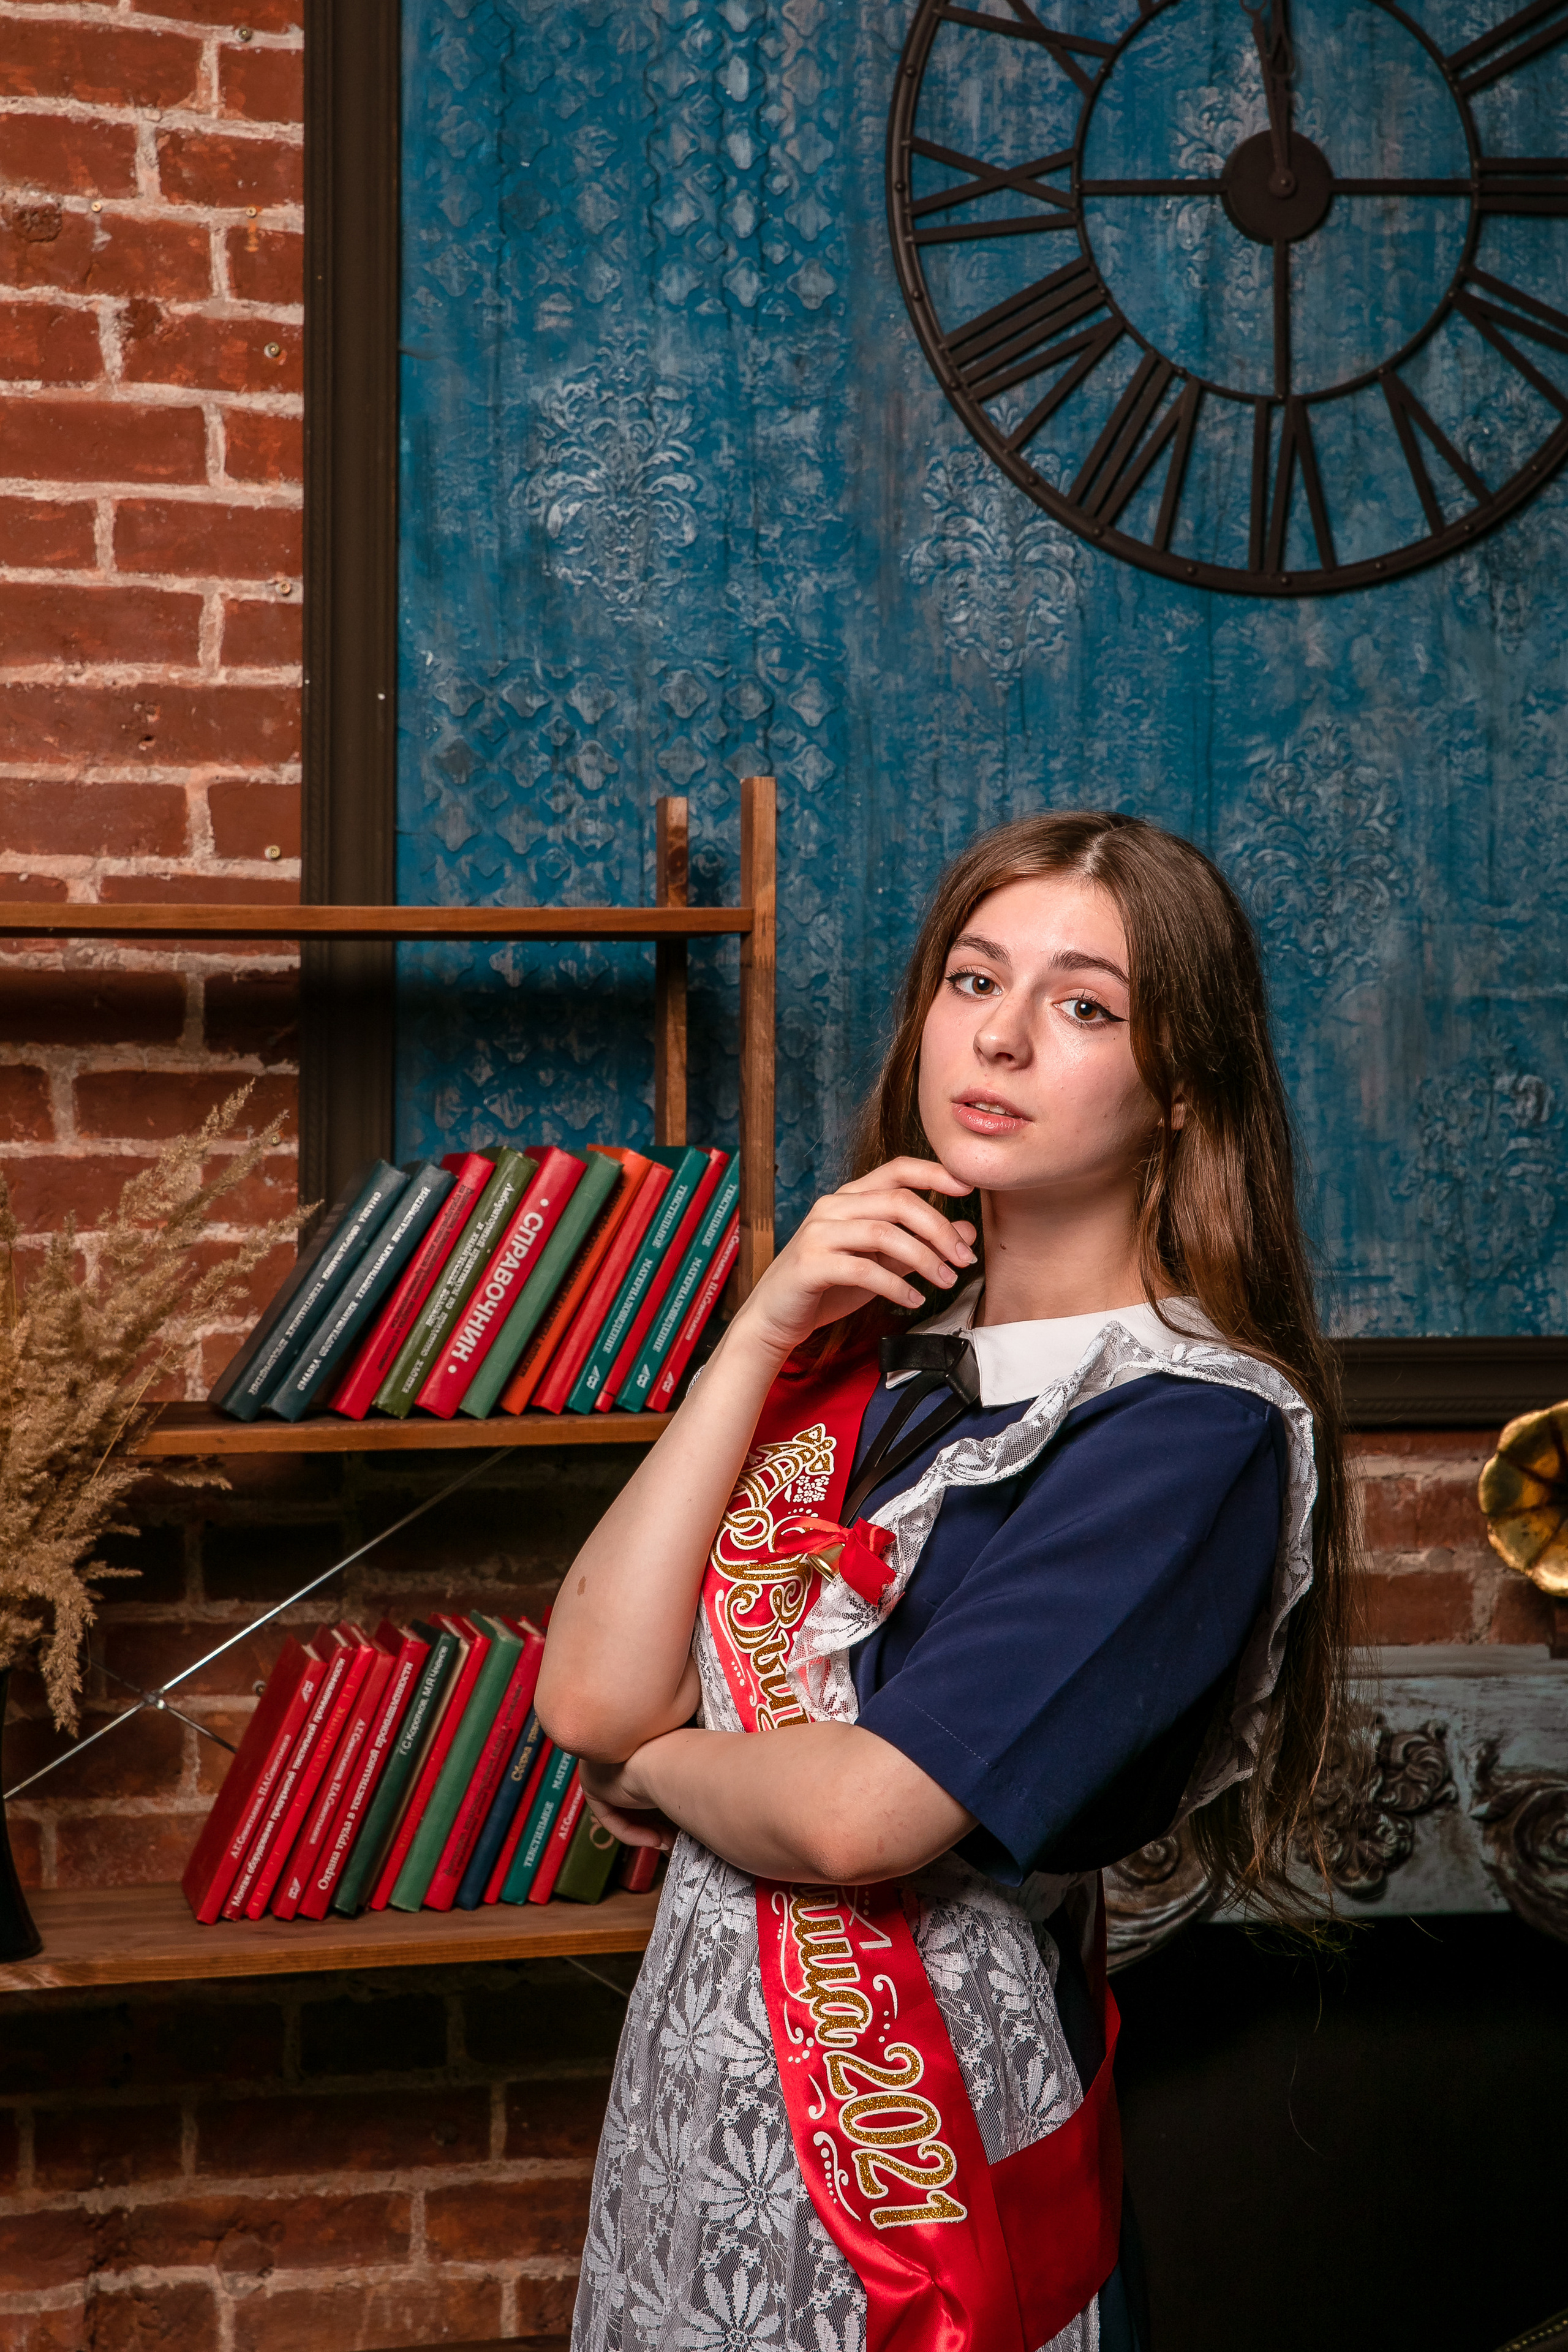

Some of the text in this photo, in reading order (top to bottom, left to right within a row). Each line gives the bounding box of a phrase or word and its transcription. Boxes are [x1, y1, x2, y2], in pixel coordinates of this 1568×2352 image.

[358, 1191, 382, 1223] СМАЗКА
[477, 1182, 516, 1248] Лабораторный
[426, 1221, 484, 1326] и химических волокон
[445, 1294, 456, 1310] по
[451, 1212, 544, 1362] СПРАВОЧНИК
[453, 1248, 481, 1297] практикум
[602, 1184, 688, 1354] ТЕКСТИЛЬНОЕ МАТЕРИАЛОВЕДЕНИЕ
[652, 1184, 737, 1353] ТЕКСТИЛЬНОЕ МАТЕРИАЛОВЕДЕНИЕ
[401, 1360, 424, 1393] хлопка
[231, 1873, 252, 1907] Монтаж
[247, 1820, 276, 1874] оборудования
[271, 1770, 296, 1821] предприятий
[292, 1723, 318, 1771] текстильной
[313, 1658, 346, 1723] промышленности
[317, 1662, 414, 1891] Охрана труда в текстильной промышленности
[522, 1801, 554, 1868] ТЕКСТИЛЬНОЕ
[823, 2042, 968, 2230] 2021
